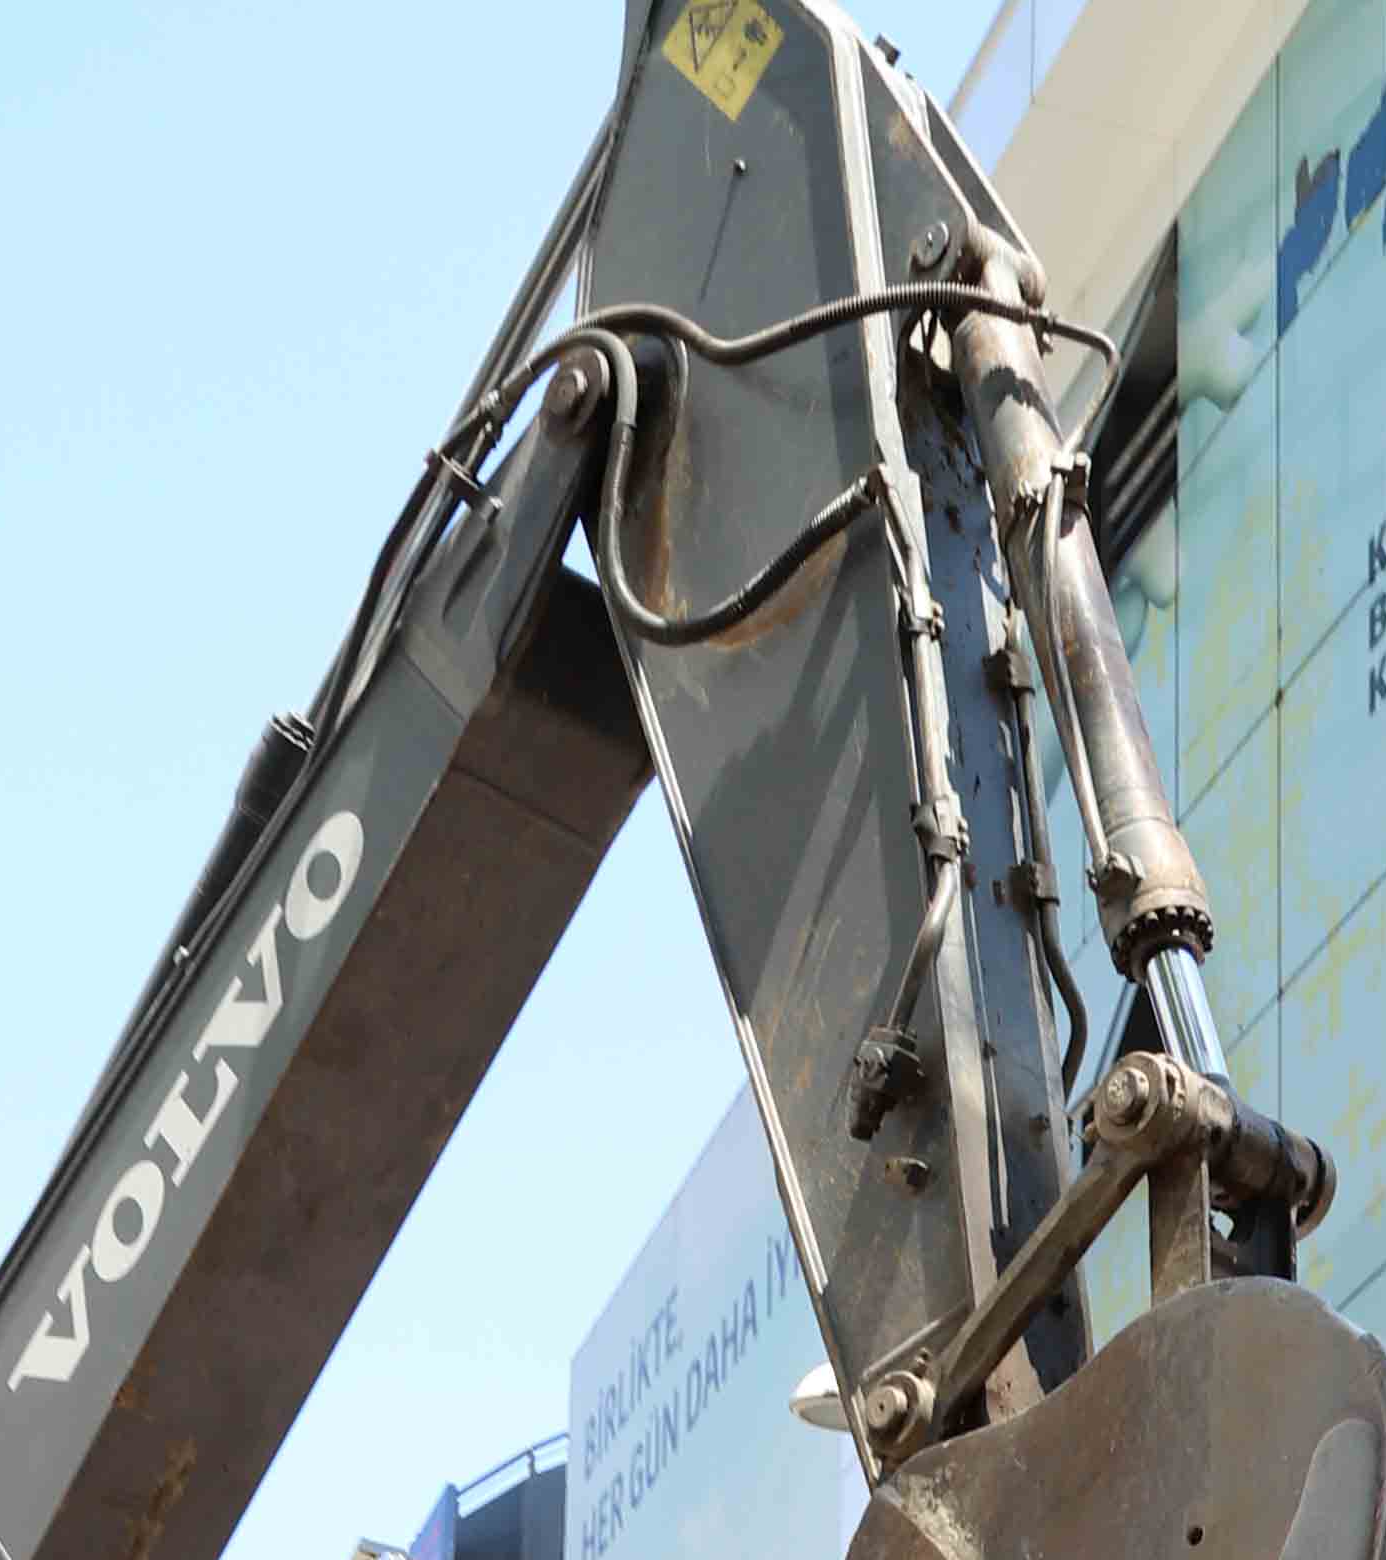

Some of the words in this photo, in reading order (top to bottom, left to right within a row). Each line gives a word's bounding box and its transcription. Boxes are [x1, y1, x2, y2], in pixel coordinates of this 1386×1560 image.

[7, 810, 365, 1392] VOLVO
[628, 1386, 680, 1511] GÜN
[686, 1276, 759, 1433] DAHA
